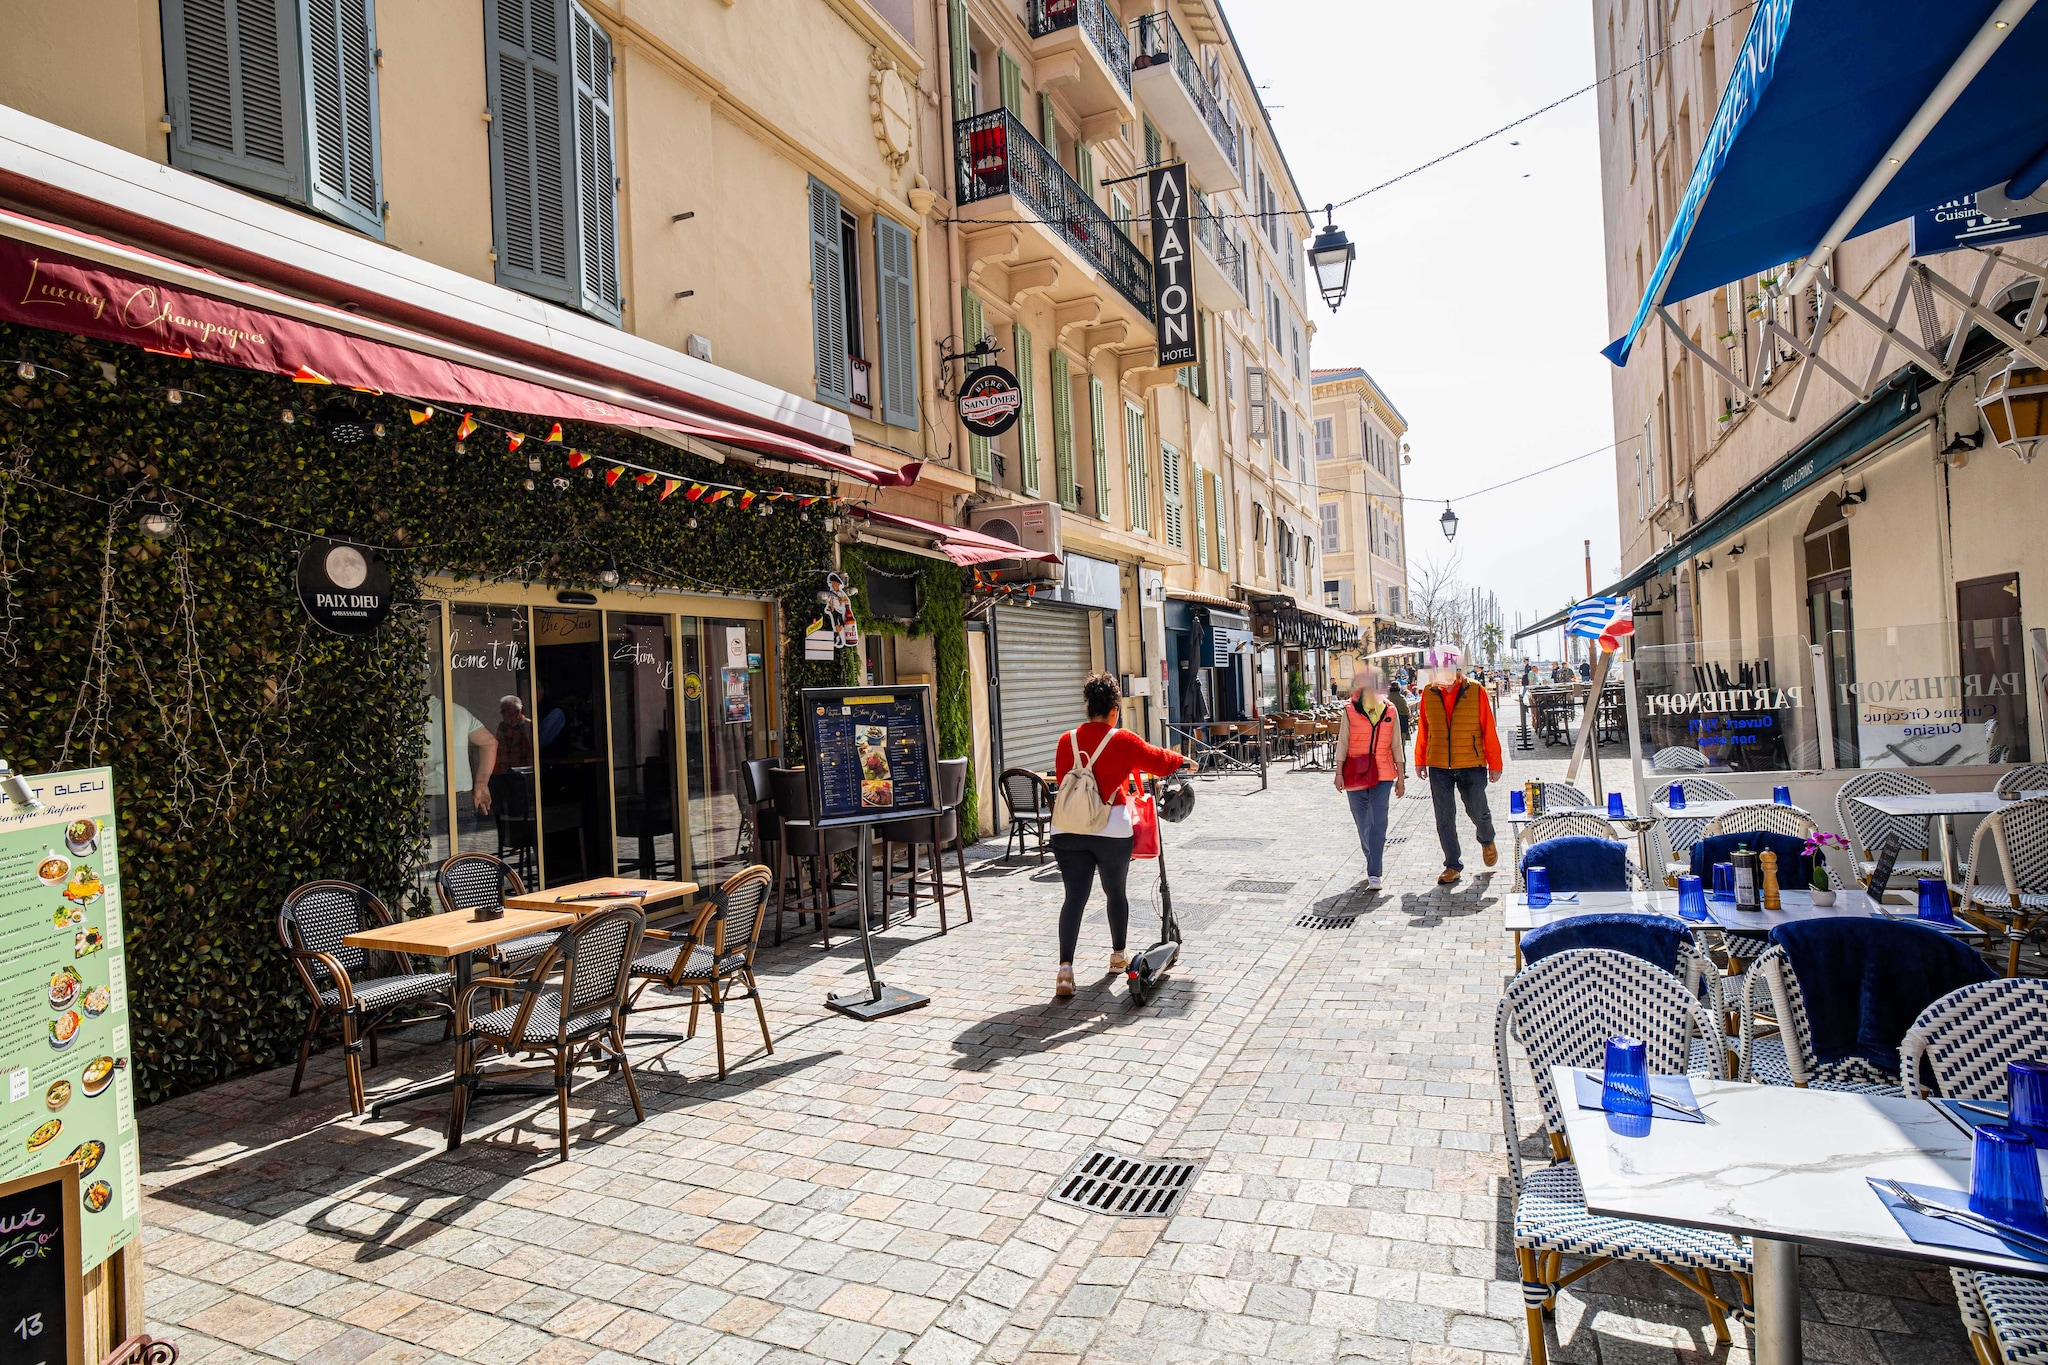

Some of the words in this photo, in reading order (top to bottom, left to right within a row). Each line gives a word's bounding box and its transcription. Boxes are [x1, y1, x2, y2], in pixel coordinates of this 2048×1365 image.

[20, 258, 108, 319] Luxury
[124, 286, 266, 350] Champagnes
[1162, 348, 1195, 361] HOTEL
[1782, 474, 1794, 492] FOOD
[1798, 460, 1814, 482] DRINKS
[316, 594, 348, 608] PAIX
[350, 595, 379, 609] DIEU
[488, 640, 505, 670] to
[506, 640, 526, 672] the
[613, 642, 656, 665] Stars
[54, 780, 104, 796] BLEU
[14, 1312, 44, 1341] 13
